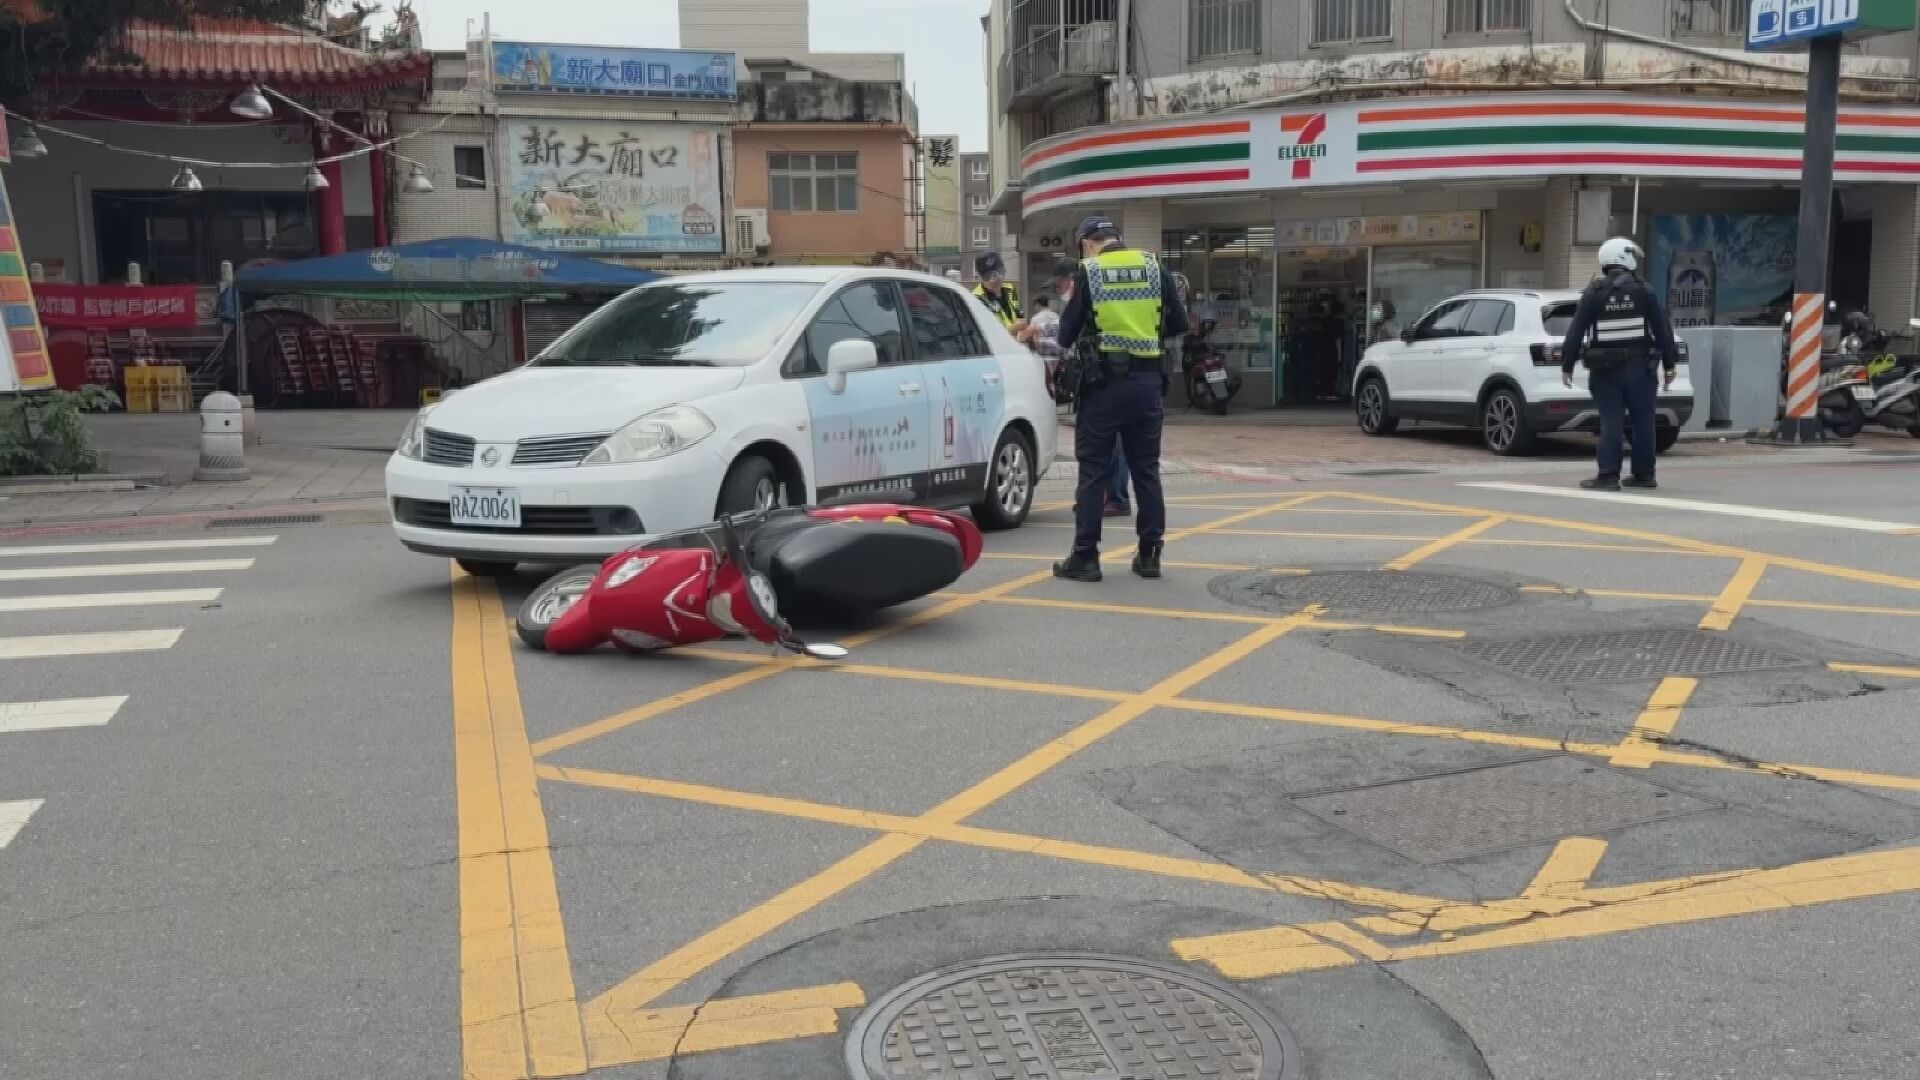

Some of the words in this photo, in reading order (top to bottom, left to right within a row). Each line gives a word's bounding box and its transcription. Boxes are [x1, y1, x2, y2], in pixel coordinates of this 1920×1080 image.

[566, 58, 671, 88] 新大廟口
[519, 126, 679, 177] 新大廟口
[928, 139, 955, 168] 髮
[1281, 113, 1327, 179] 7
